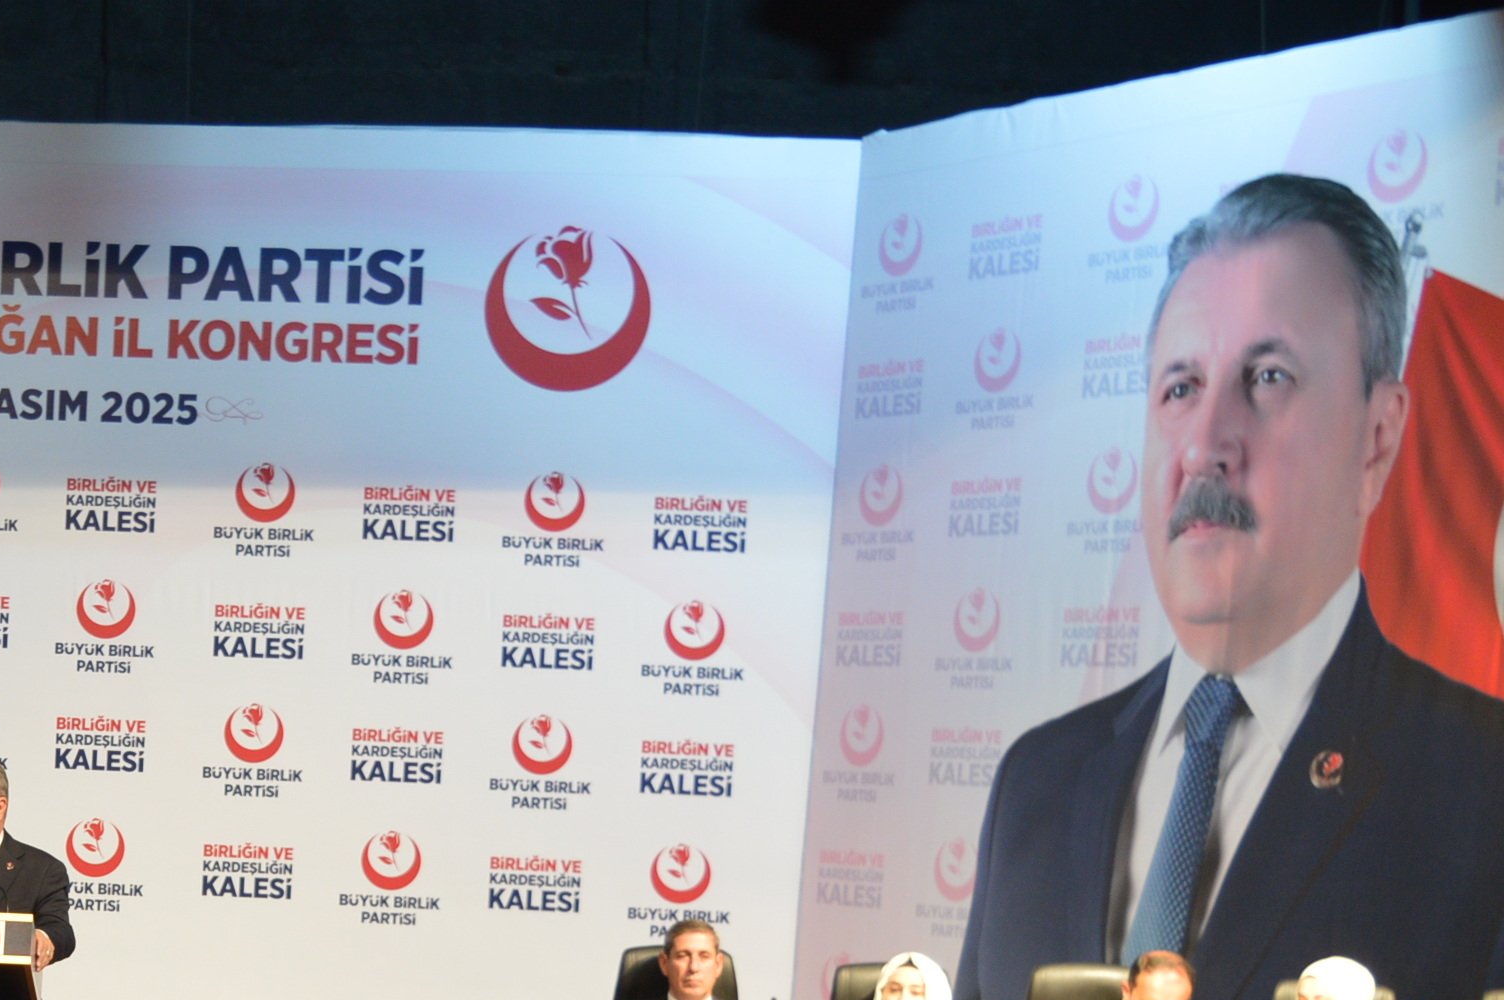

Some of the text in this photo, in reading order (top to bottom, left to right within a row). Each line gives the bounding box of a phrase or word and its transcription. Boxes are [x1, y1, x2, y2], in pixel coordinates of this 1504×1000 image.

[167, 244, 425, 306] PARTİSİ
[112, 316, 154, 359] İL
[167, 319, 419, 365] KONGRESİ
[100, 390, 199, 426] 2025
[66, 476, 157, 494] BİRLİĞİN VE
[654, 495, 748, 514] BİRLİĞİN VE
[64, 508, 156, 534] KALESİ
[501, 535, 604, 552] BÜYÜK BİRLİK
[652, 527, 747, 554] KALESİ
[523, 552, 581, 568] PARTİSİ
[502, 612, 596, 632] BİRLİĞİN VE
[350, 652, 453, 670] BÜYÜK BİRLİK
[500, 645, 594, 672] KALESİ
[372, 670, 429, 686] PARTİSİ
[640, 663, 744, 681] BÜYÜK BİRLİK
[662, 681, 720, 697] PARTİSİ
[55, 715, 147, 734] BİRLİĞİN VE
[641, 739, 734, 758] BİRLİĞİN VE
[54, 747, 145, 773] KALESİ
[488, 777, 591, 795] BÜYÜK BİRLİK
[639, 771, 733, 798] KALESİ
[511, 795, 568, 811] PARTİSİ
[202, 842, 294, 861] BİRLİĞİN VE
[489, 855, 582, 874] BİRLİĞİN VE
[97, 882, 144, 897] BİRLİK
[201, 874, 293, 900] KALESİ
[338, 893, 440, 911] BÜYÜK BİRLİK
[487, 887, 580, 914] KALESİ
[360, 910, 417, 926] PARTİSİ
